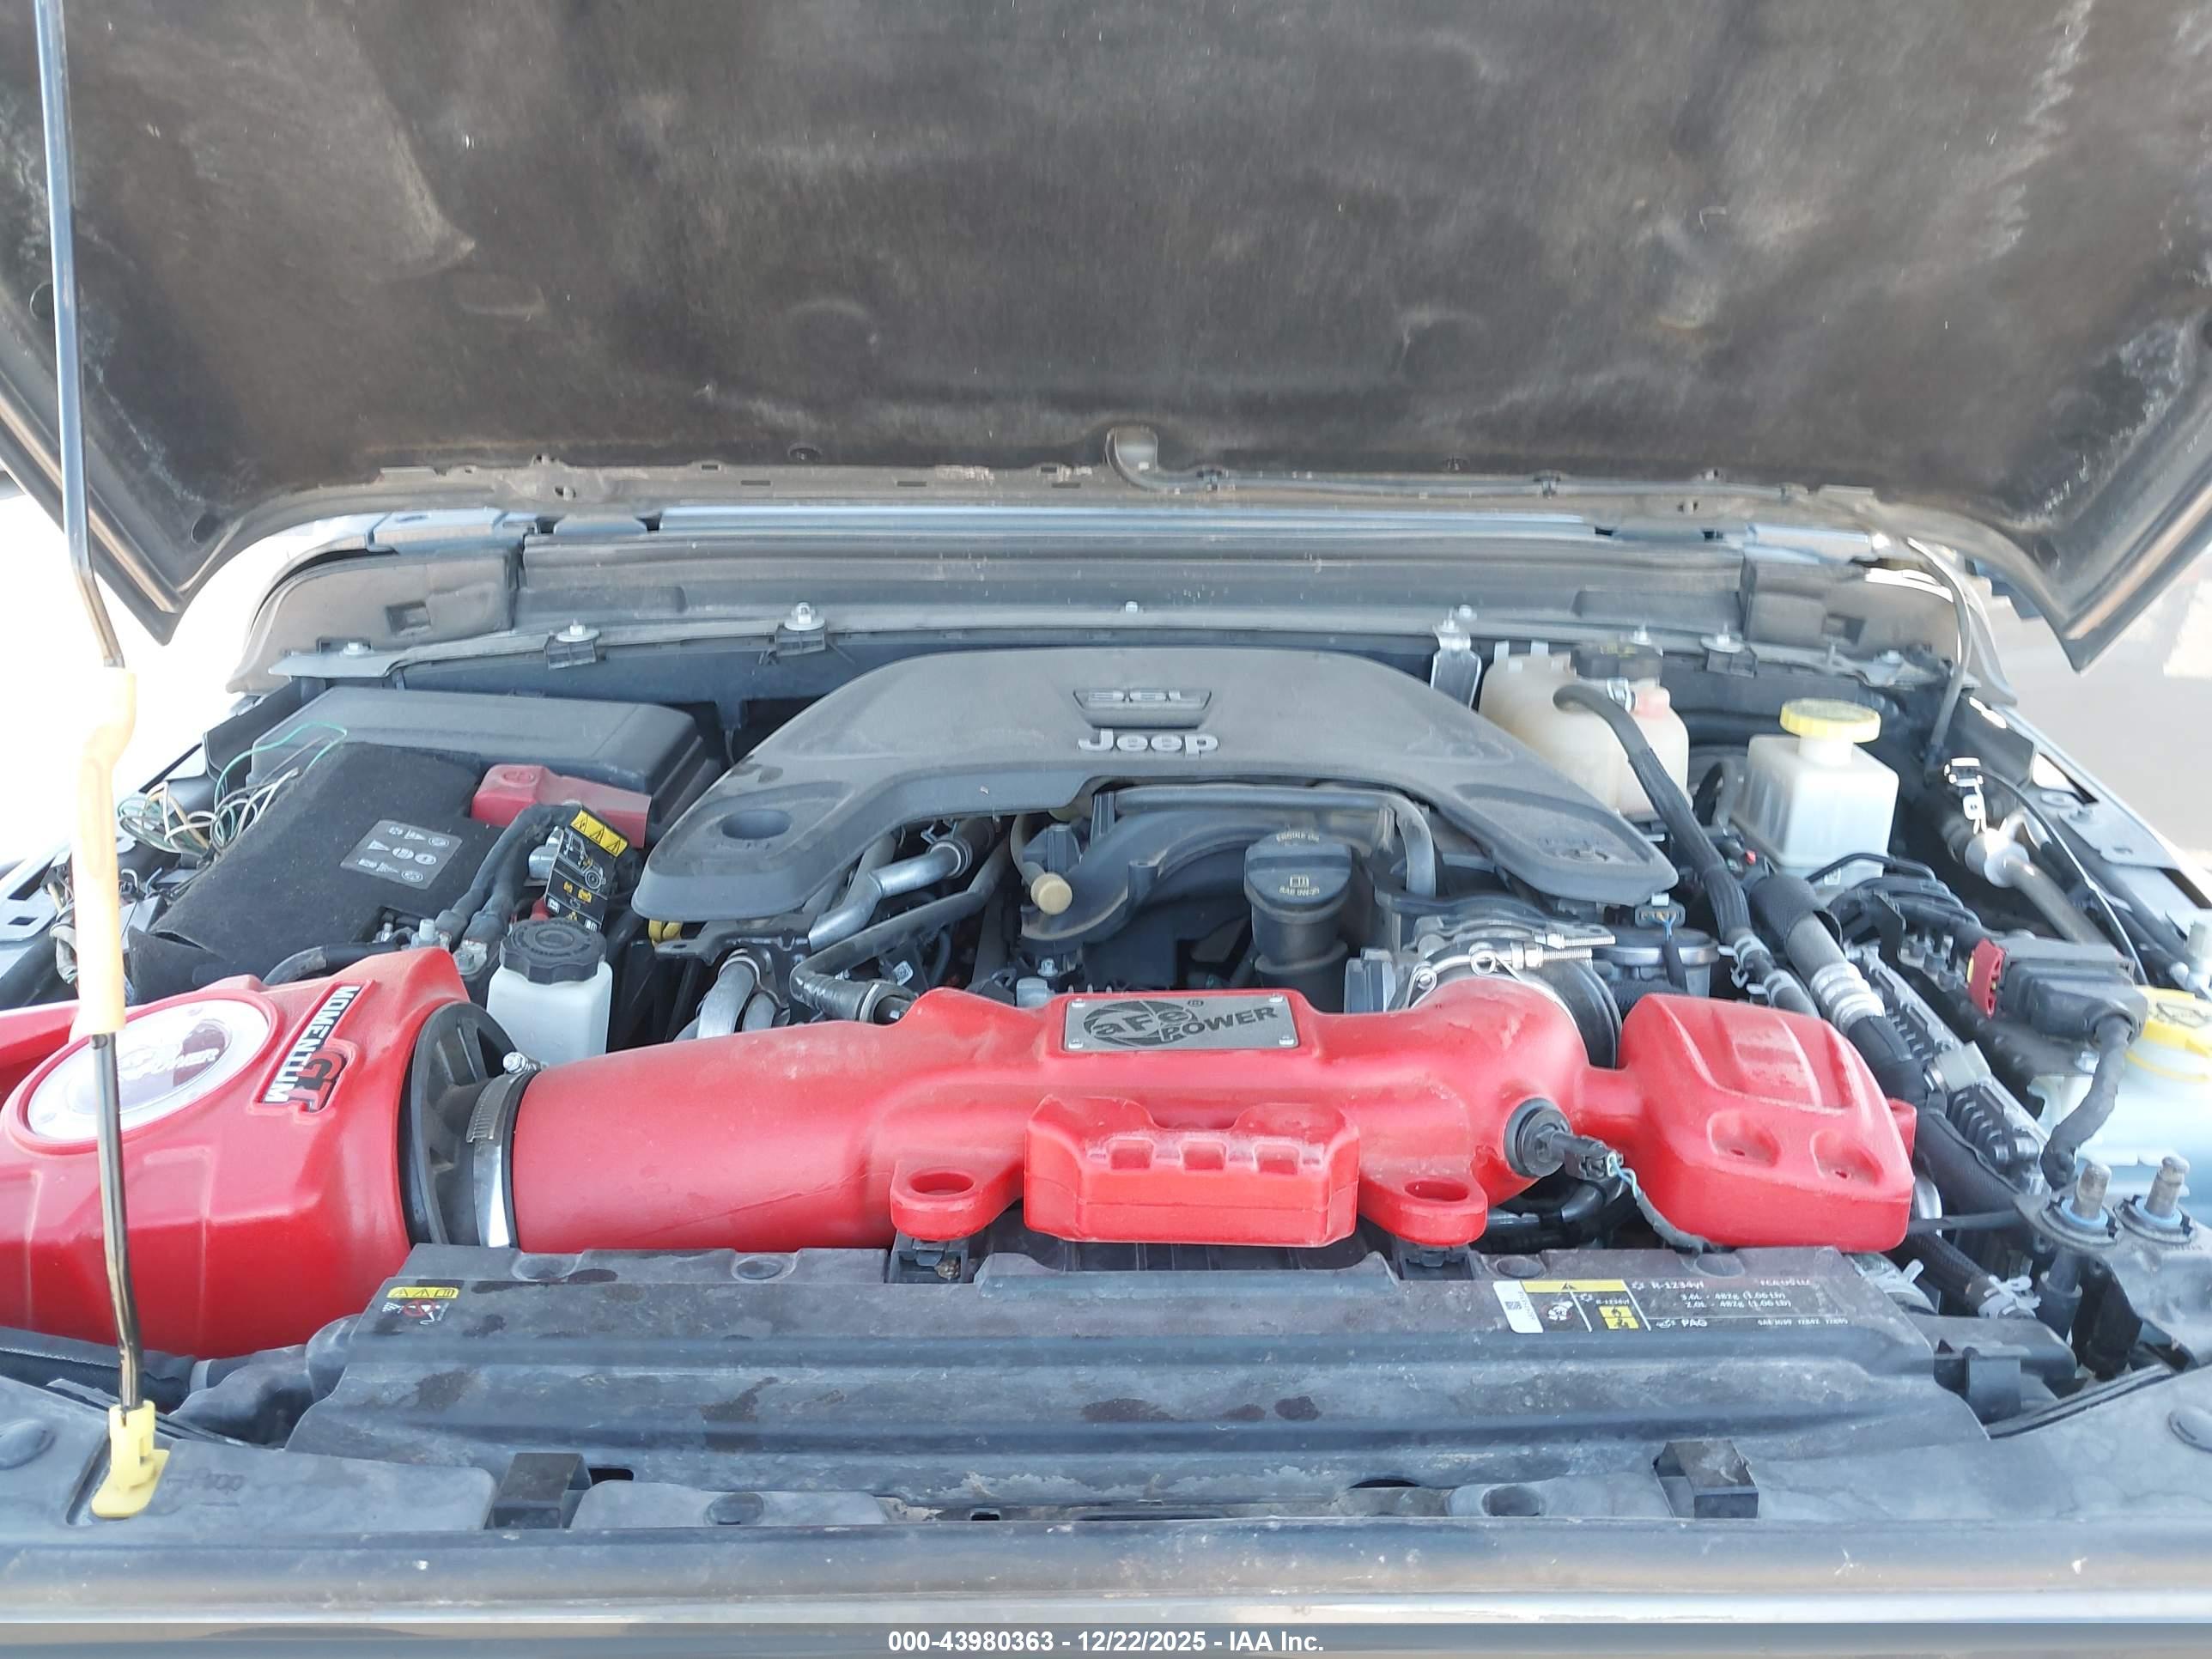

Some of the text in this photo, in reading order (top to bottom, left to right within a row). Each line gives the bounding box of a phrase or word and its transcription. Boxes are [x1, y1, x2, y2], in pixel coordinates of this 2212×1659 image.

[1077, 727, 1219, 757] Jeep
[264, 985, 363, 1103] MOMENTUM
[1160, 1006, 1279, 1042] POWER
[295, 1050, 345, 1113] GT
